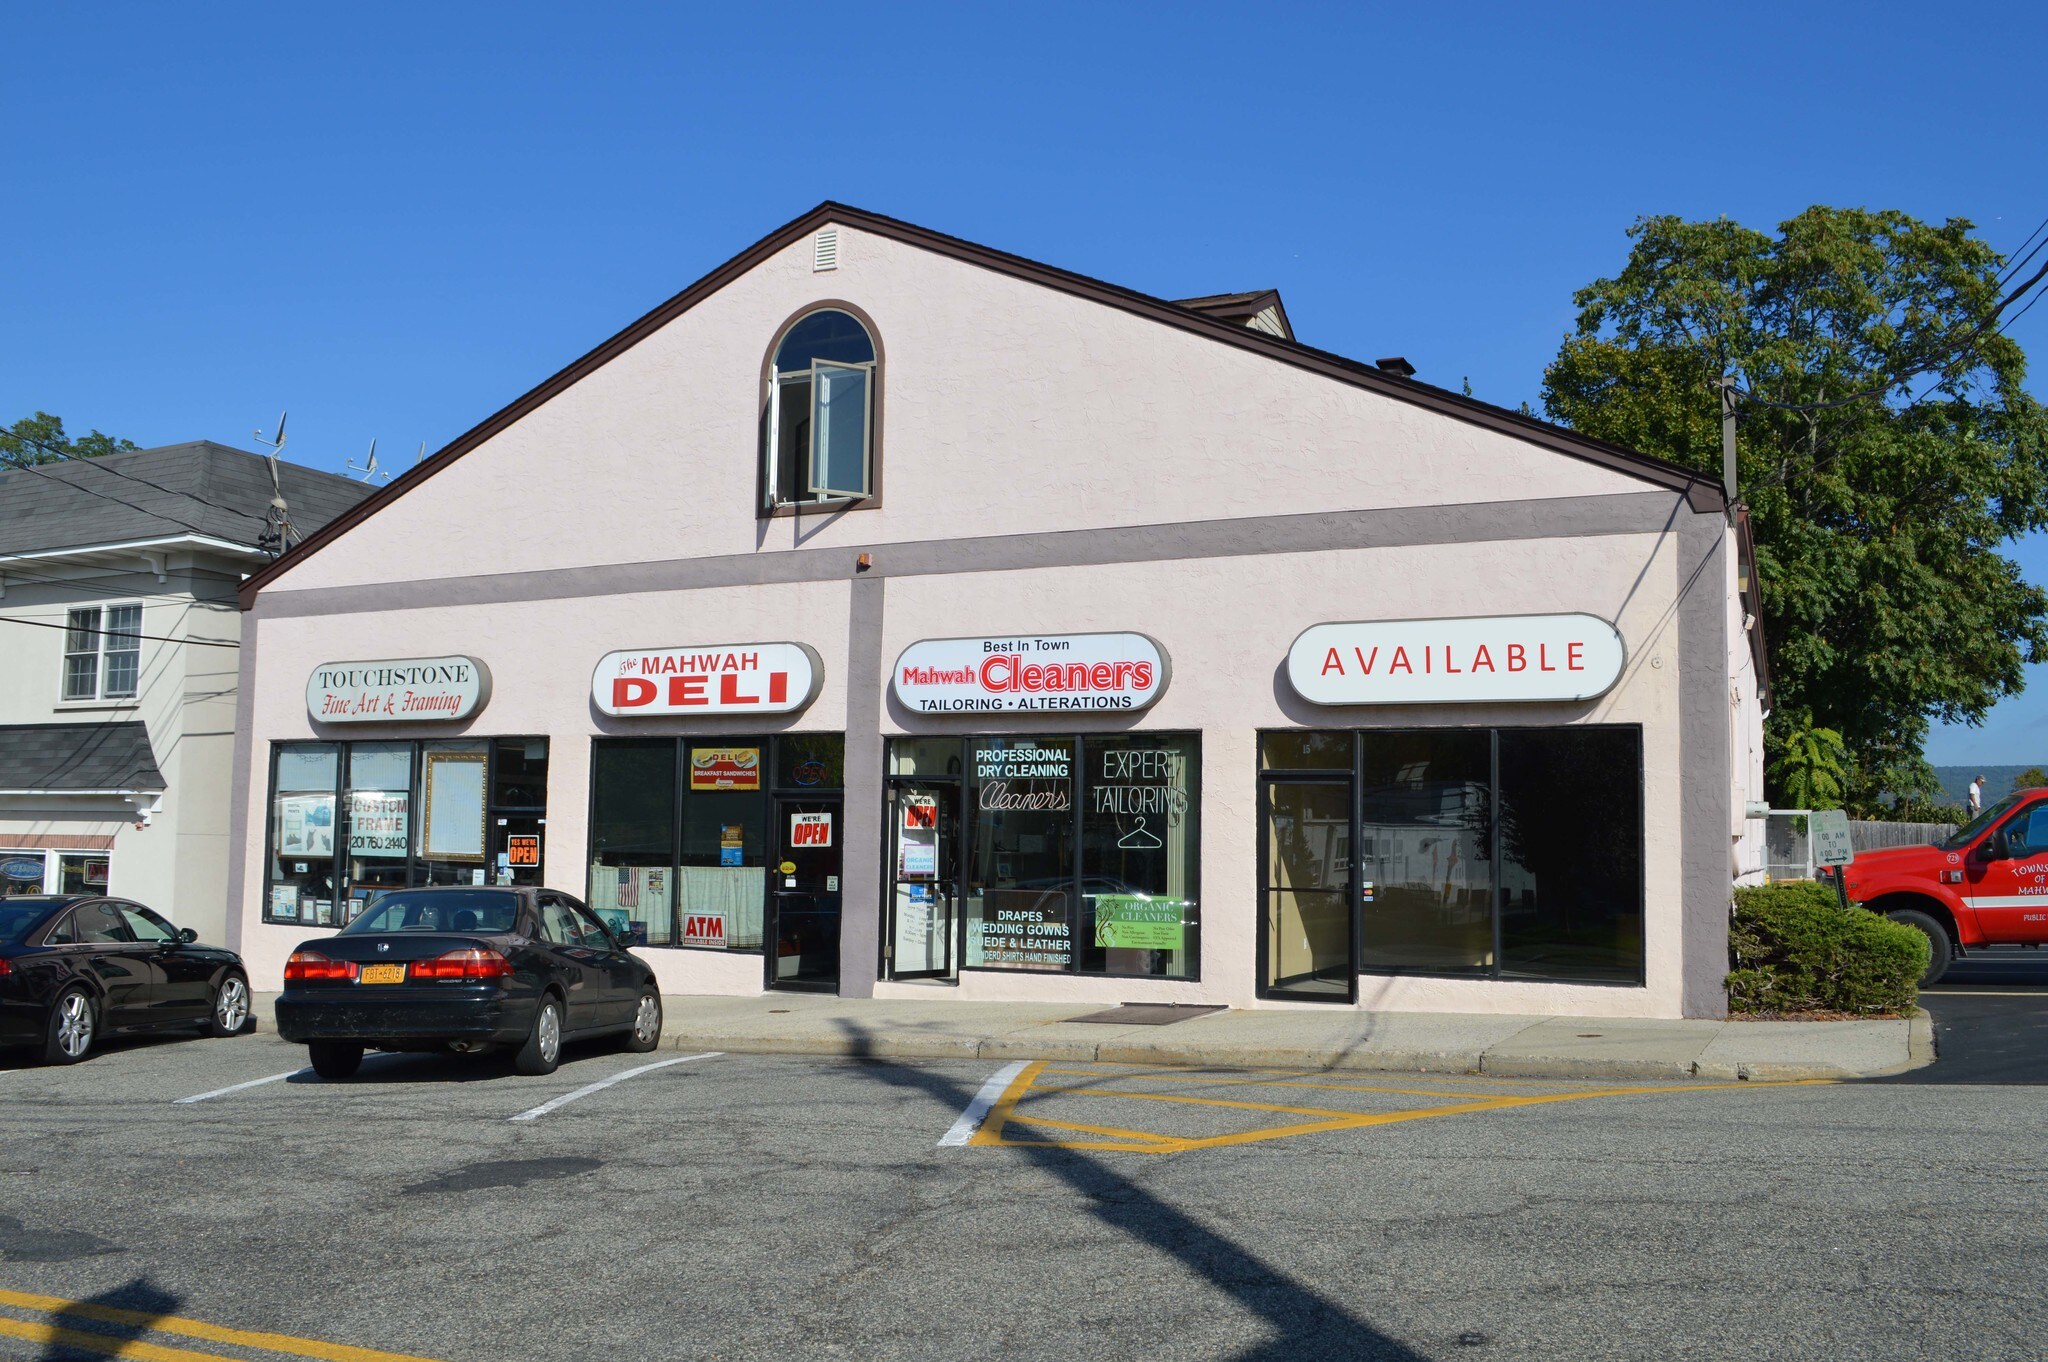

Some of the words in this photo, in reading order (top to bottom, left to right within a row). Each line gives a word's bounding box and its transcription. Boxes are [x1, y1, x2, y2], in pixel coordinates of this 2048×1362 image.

[983, 640, 1013, 652] Best
[1018, 640, 1029, 651] In
[1034, 639, 1070, 651] Town
[620, 657, 638, 675] The
[641, 652, 758, 674] MAHWAH
[1321, 642, 1584, 676] AVAILABLE
[319, 665, 469, 689] TOUCHSTONE
[902, 664, 975, 685] Mahwah
[979, 654, 1152, 693] Cleaners
[612, 672, 788, 707] DELI
[322, 694, 351, 715] Fine
[352, 692, 380, 715] Art
[383, 693, 395, 715] &
[402, 690, 462, 716] Framing
[920, 698, 1003, 711] TAILORING
[1018, 696, 1132, 710] ALTERATIONS
[976, 749, 1070, 762] PROFESSIONAL
[978, 764, 1000, 777] DRY
[1004, 764, 1068, 777] CLEANING
[1103, 750, 1180, 778] EXPERT
[980, 780, 1070, 810] Cleaners
[1094, 786, 1188, 814] TAILORING
[354, 800, 407, 813] CUSTOM
[906, 805, 937, 827] OPEN
[358, 817, 403, 831] FRAME
[794, 823, 829, 844] OPEN
[351, 836, 365, 848] 201
[366, 836, 383, 849] 760
[385, 836, 407, 849] 2440
[510, 847, 537, 863] OPEN
[2034, 875, 2045, 883] OF
[1125, 902, 1173, 911] ORGANIC
[998, 910, 1043, 922] DRAPES
[1121, 912, 1177, 922] CLEANERS
[686, 917, 723, 937] ATM
[972, 923, 1023, 934] WEDDING
[1027, 925, 1070, 936] GOWNS
[969, 937, 1006, 947] SUEDE
[1010, 938, 1017, 948] &
[1021, 938, 1071, 950] LEATHER
[1002, 952, 1024, 961] SHIRTS
[1025, 953, 1042, 962] HAND
[1043, 953, 1071, 964] FINISHED
